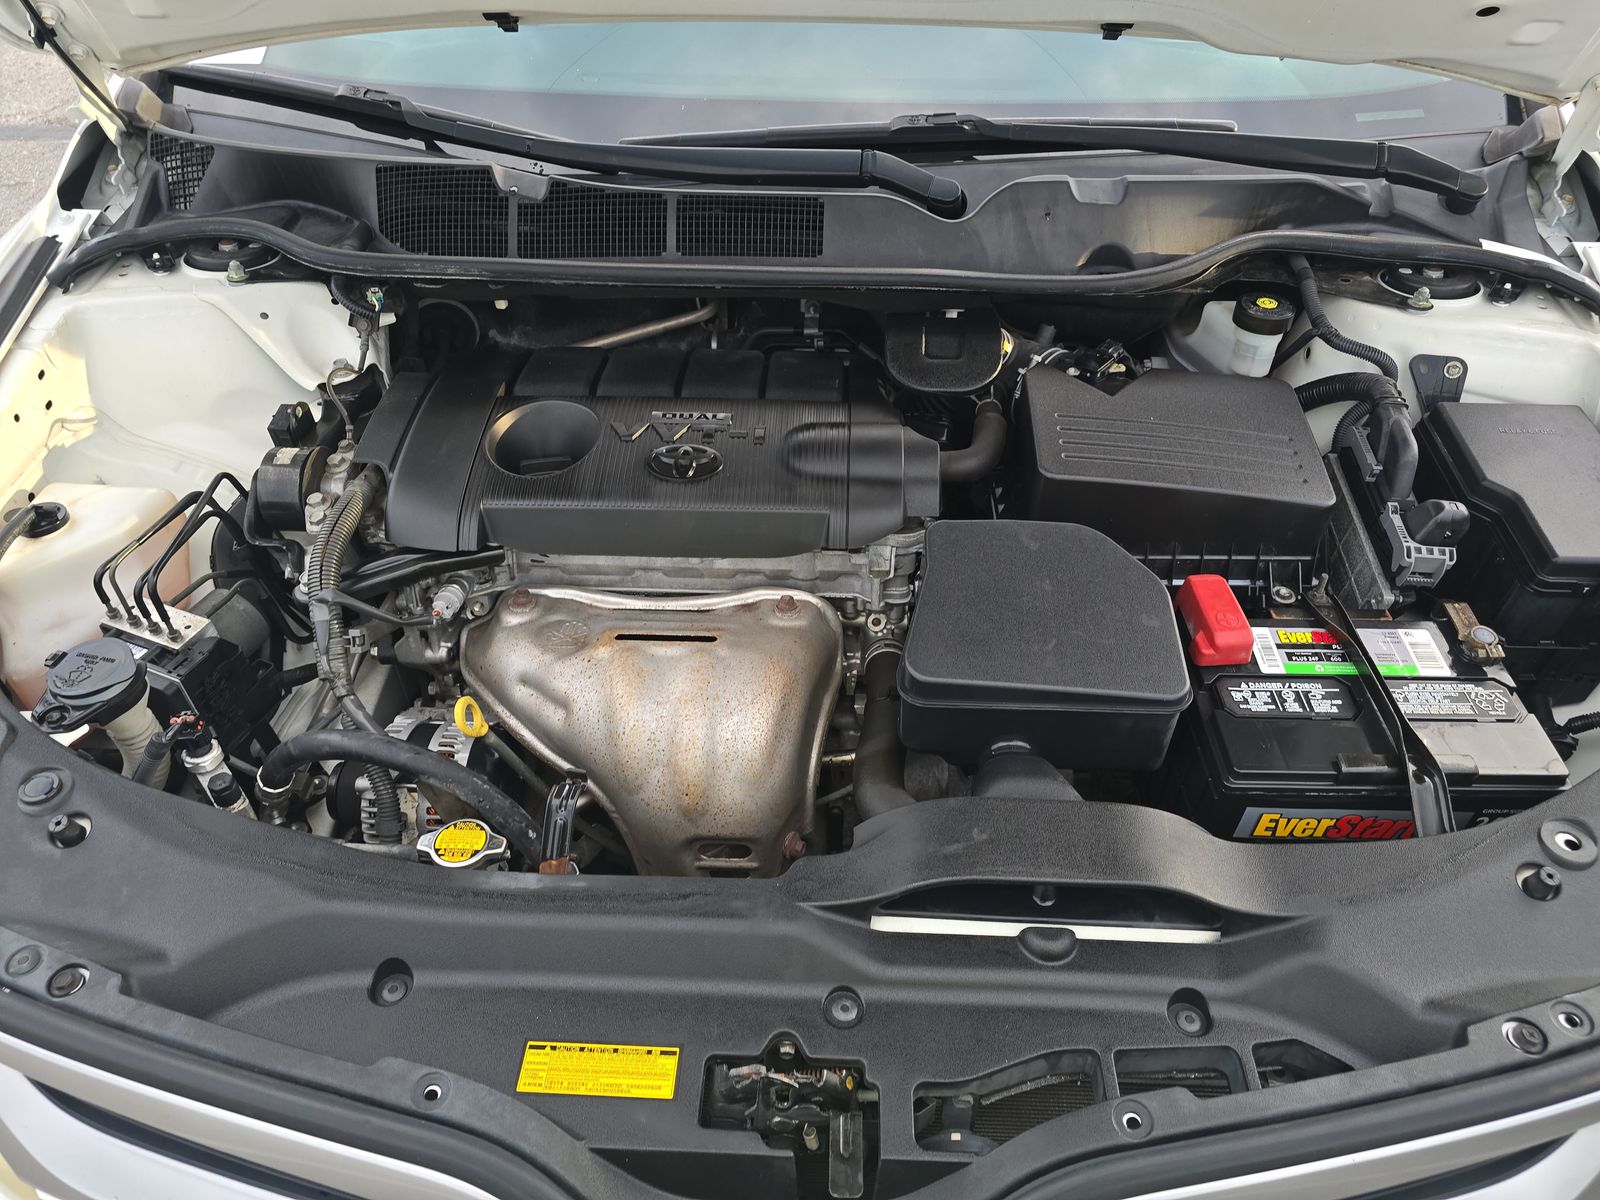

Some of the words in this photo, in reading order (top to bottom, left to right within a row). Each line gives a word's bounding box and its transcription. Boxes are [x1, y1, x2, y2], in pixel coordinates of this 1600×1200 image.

[661, 412, 725, 421] DUAL
[1276, 629, 1337, 645] EverSta
[1248, 682, 1283, 690] DANGER
[1291, 682, 1323, 690] POISON
